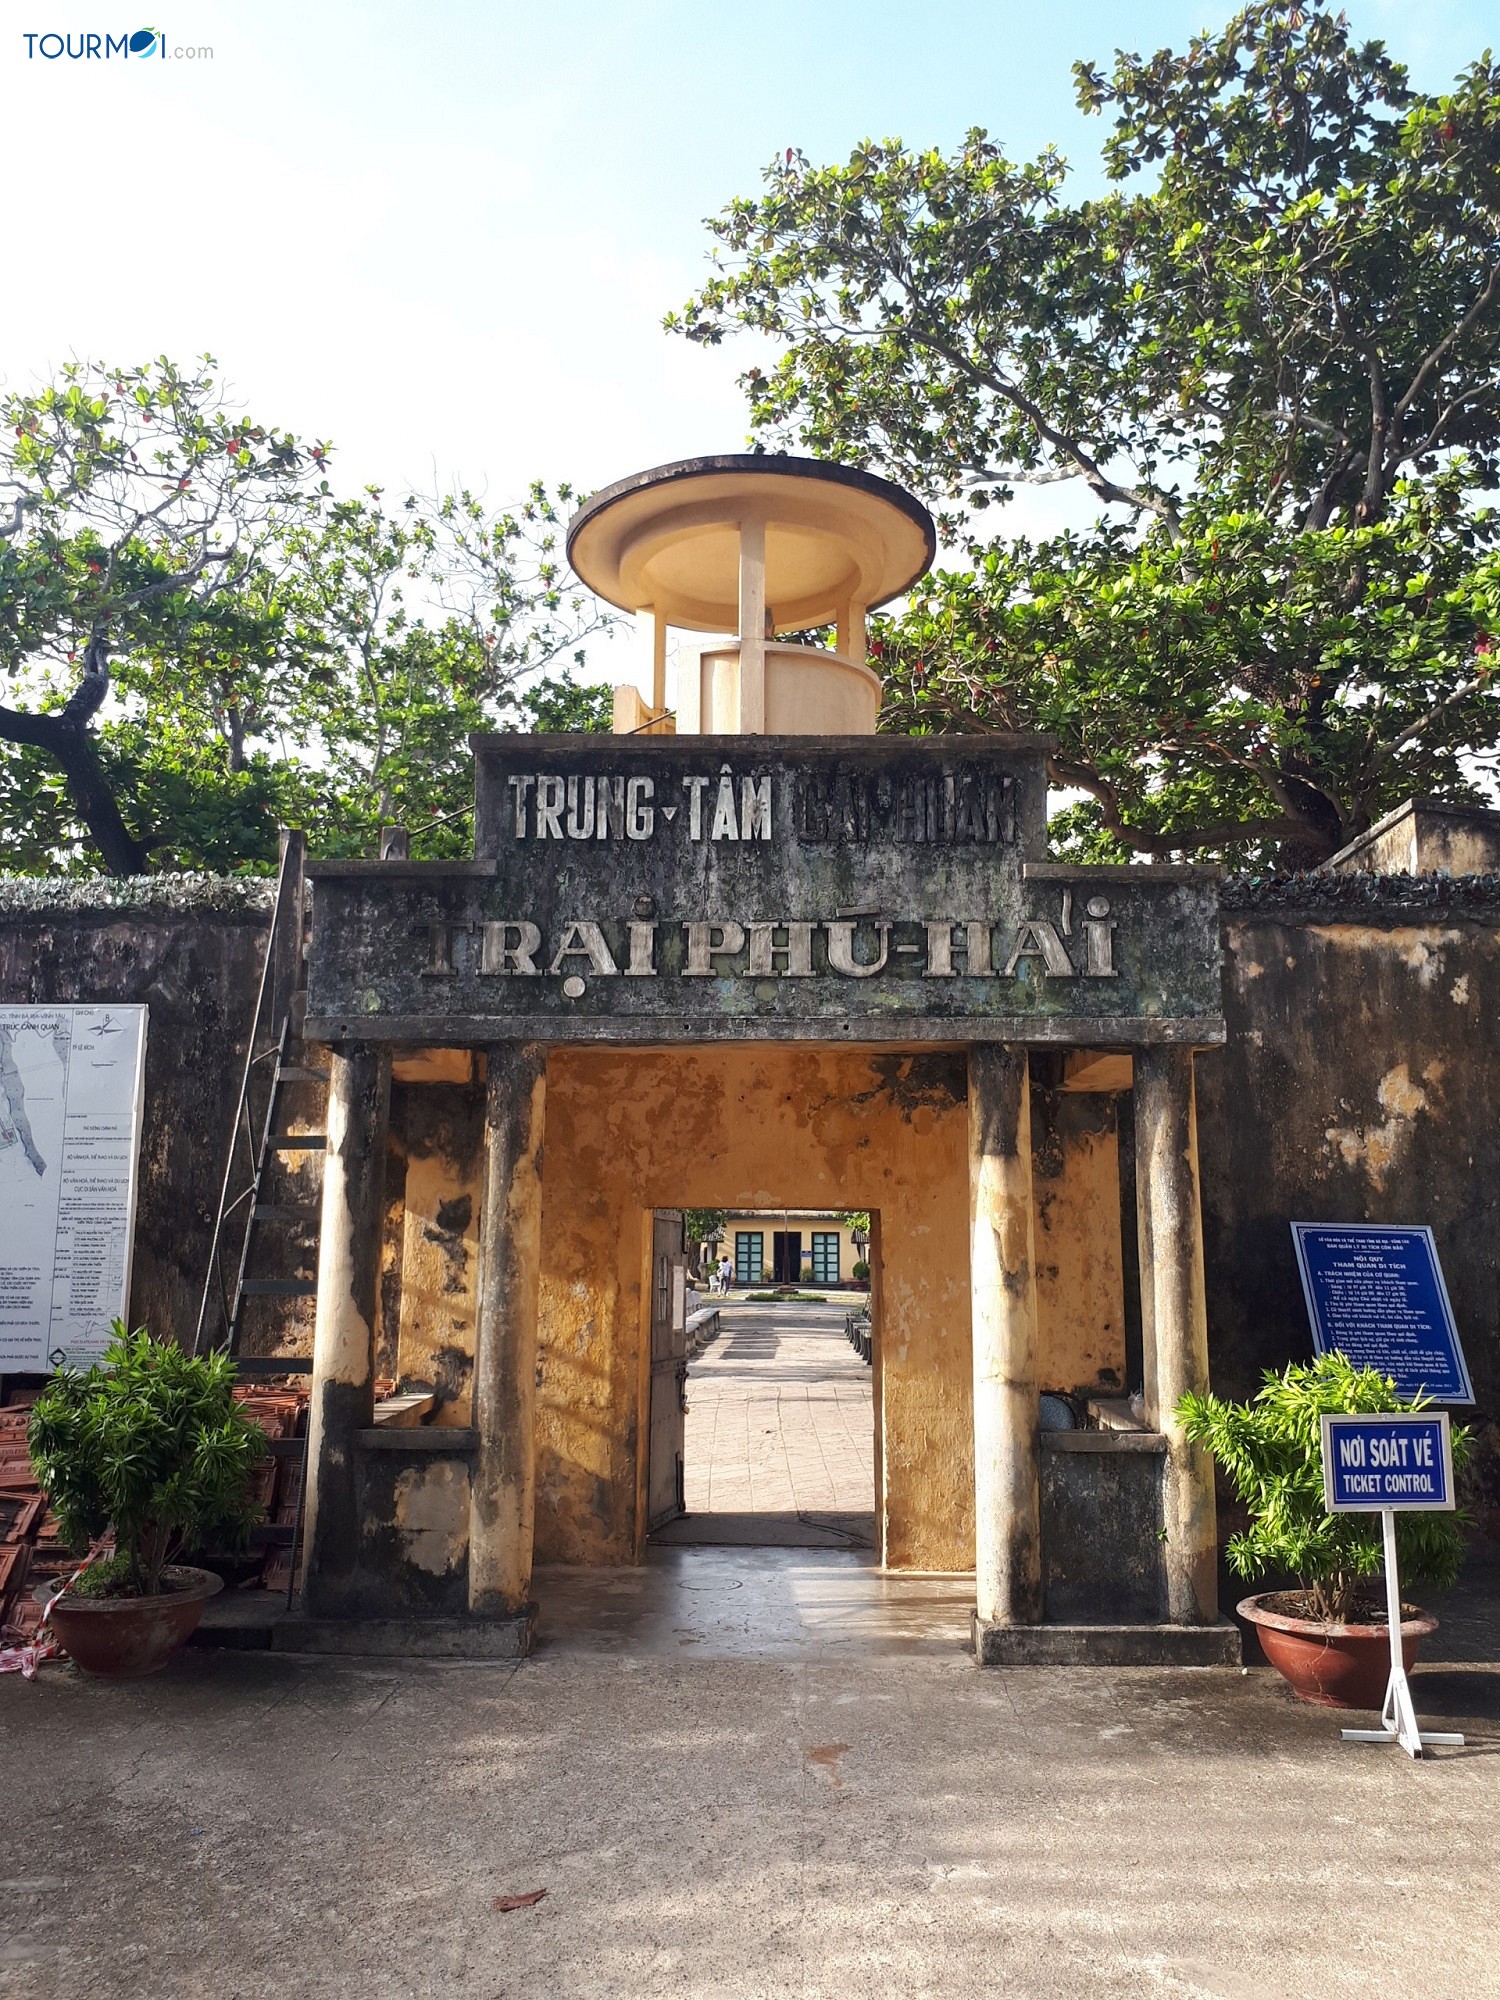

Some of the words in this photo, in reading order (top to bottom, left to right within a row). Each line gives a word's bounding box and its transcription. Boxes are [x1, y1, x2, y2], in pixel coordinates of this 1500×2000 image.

[1340, 1435, 1366, 1468] NƠI
[1369, 1431, 1408, 1468] SOÁT
[1412, 1430, 1434, 1467] VÉ
[1343, 1474, 1381, 1493] TICKET
[1384, 1474, 1434, 1493] CONTROL
